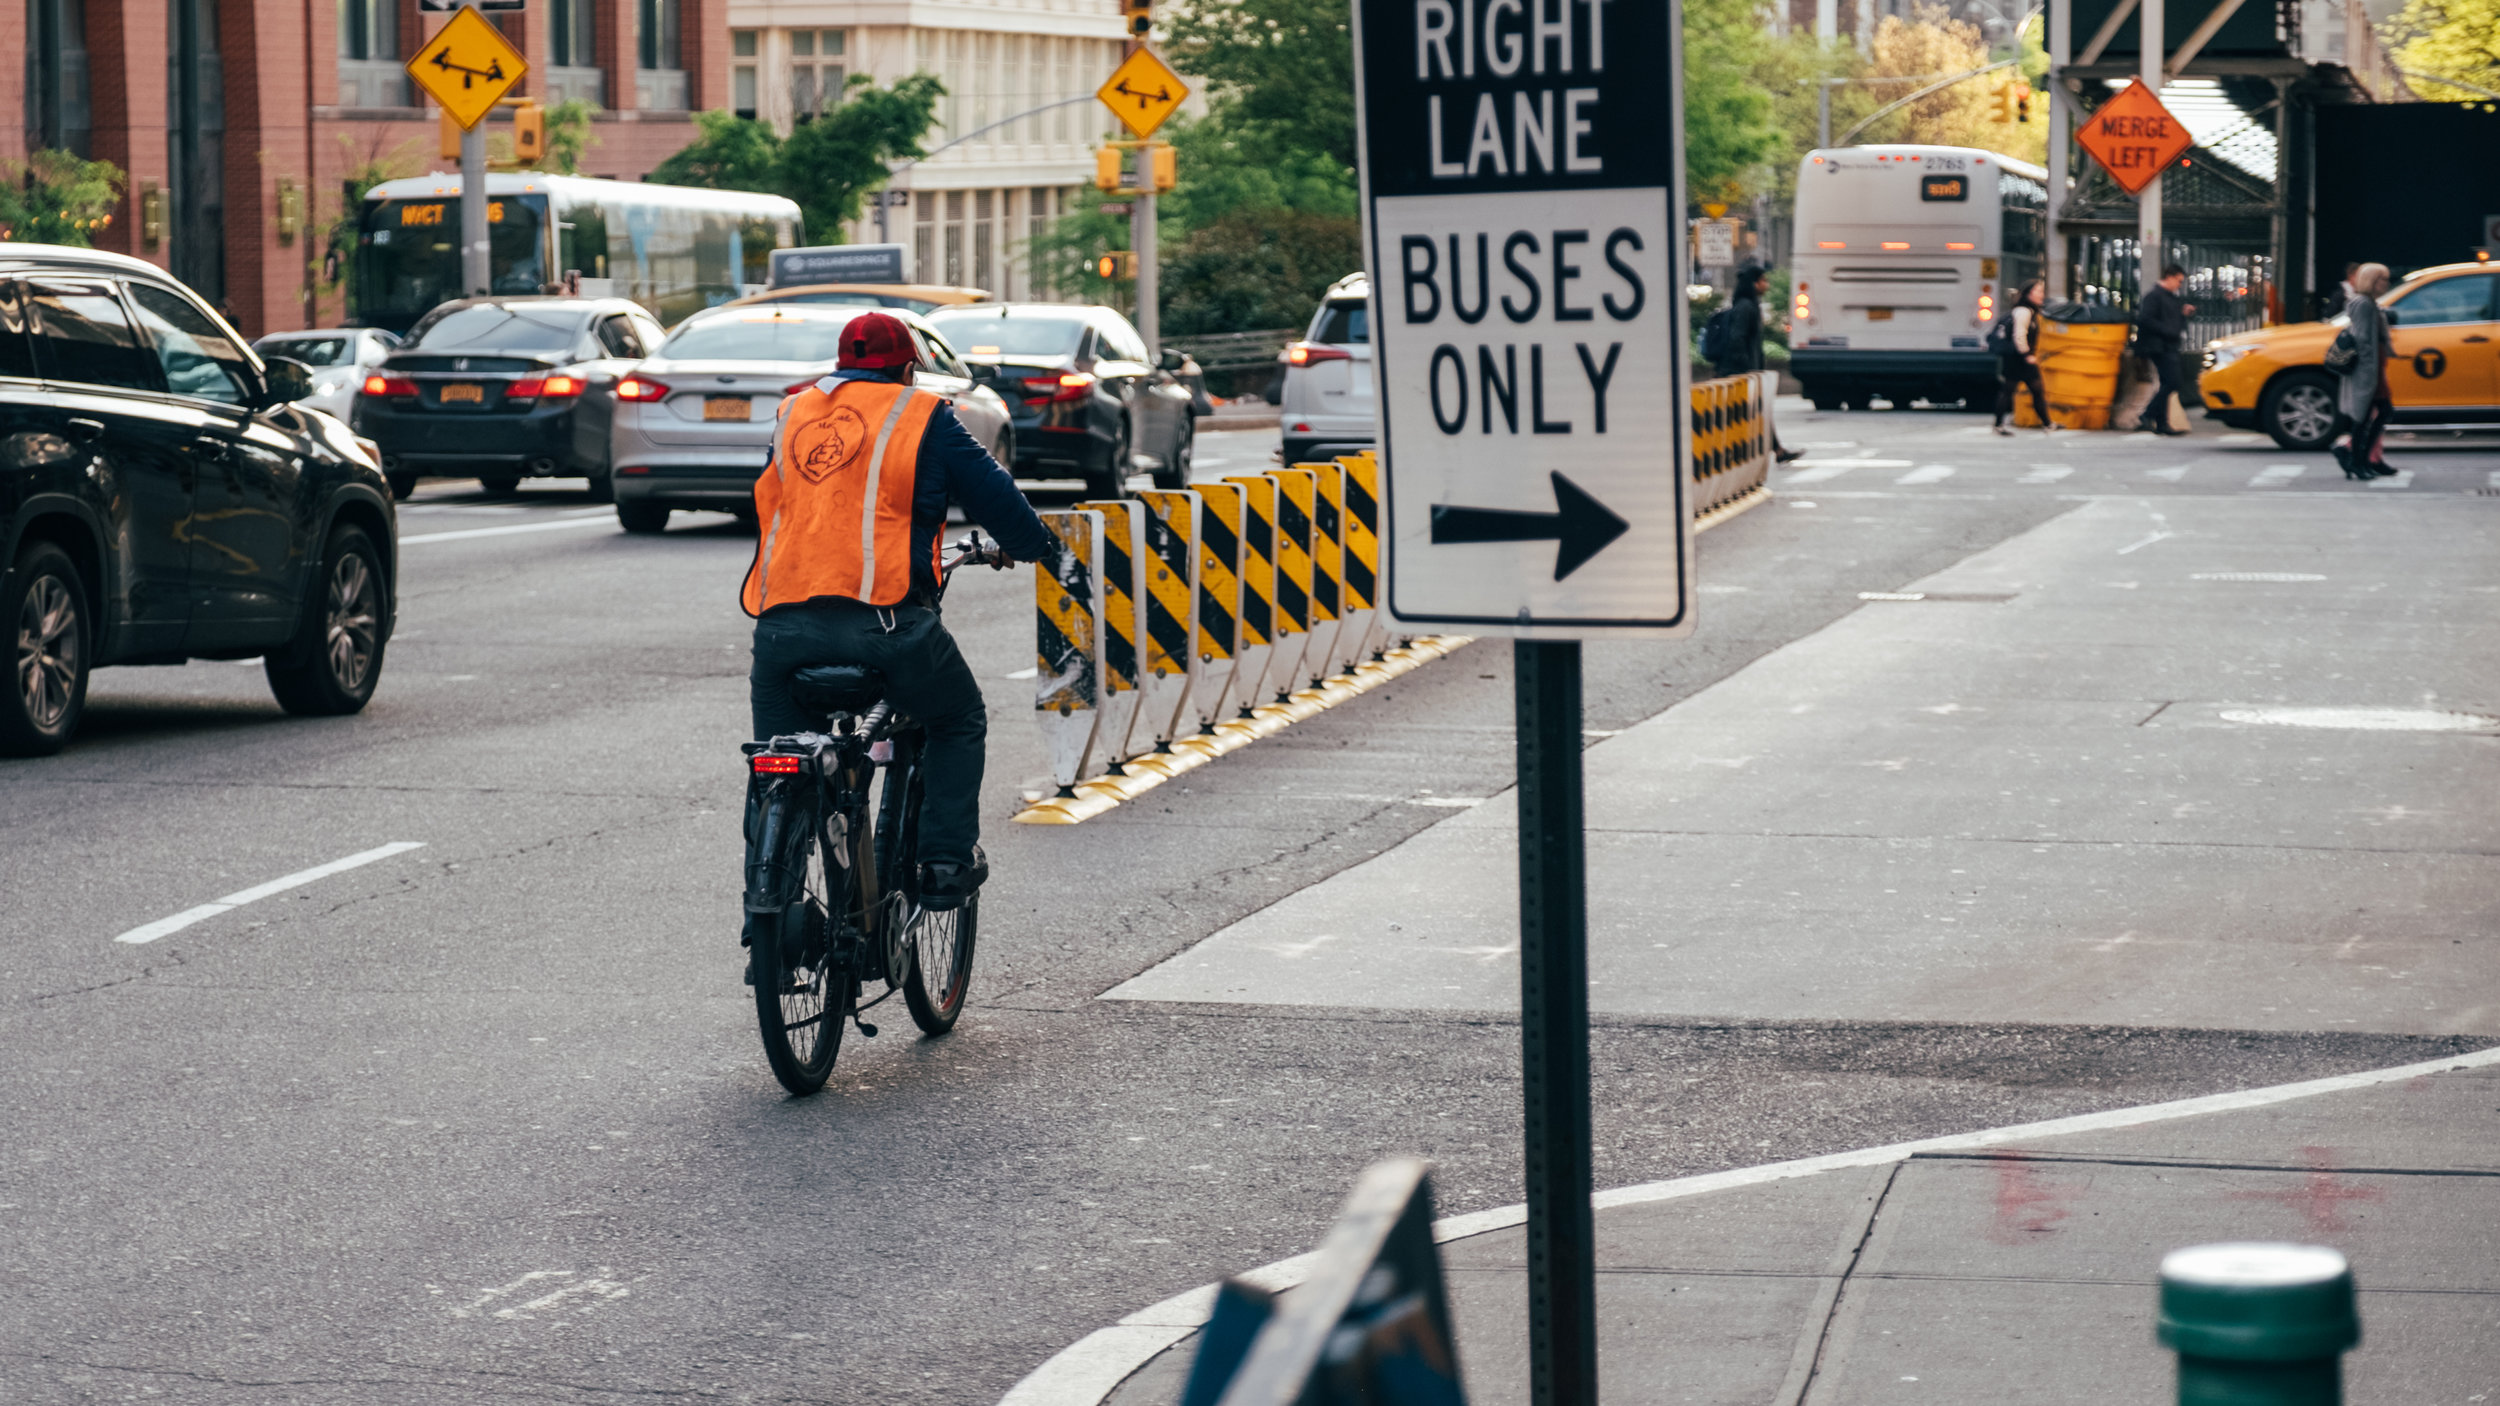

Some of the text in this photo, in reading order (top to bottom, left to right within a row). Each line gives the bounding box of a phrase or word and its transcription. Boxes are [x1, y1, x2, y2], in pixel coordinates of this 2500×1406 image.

[1415, 0, 1608, 79] RIGHT
[1429, 87, 1603, 177] LANE
[2101, 116, 2169, 138] MERGE
[2109, 146, 2158, 168] LEFT
[1401, 226, 1646, 324] BUSES
[1429, 342, 1624, 435] ONLY
